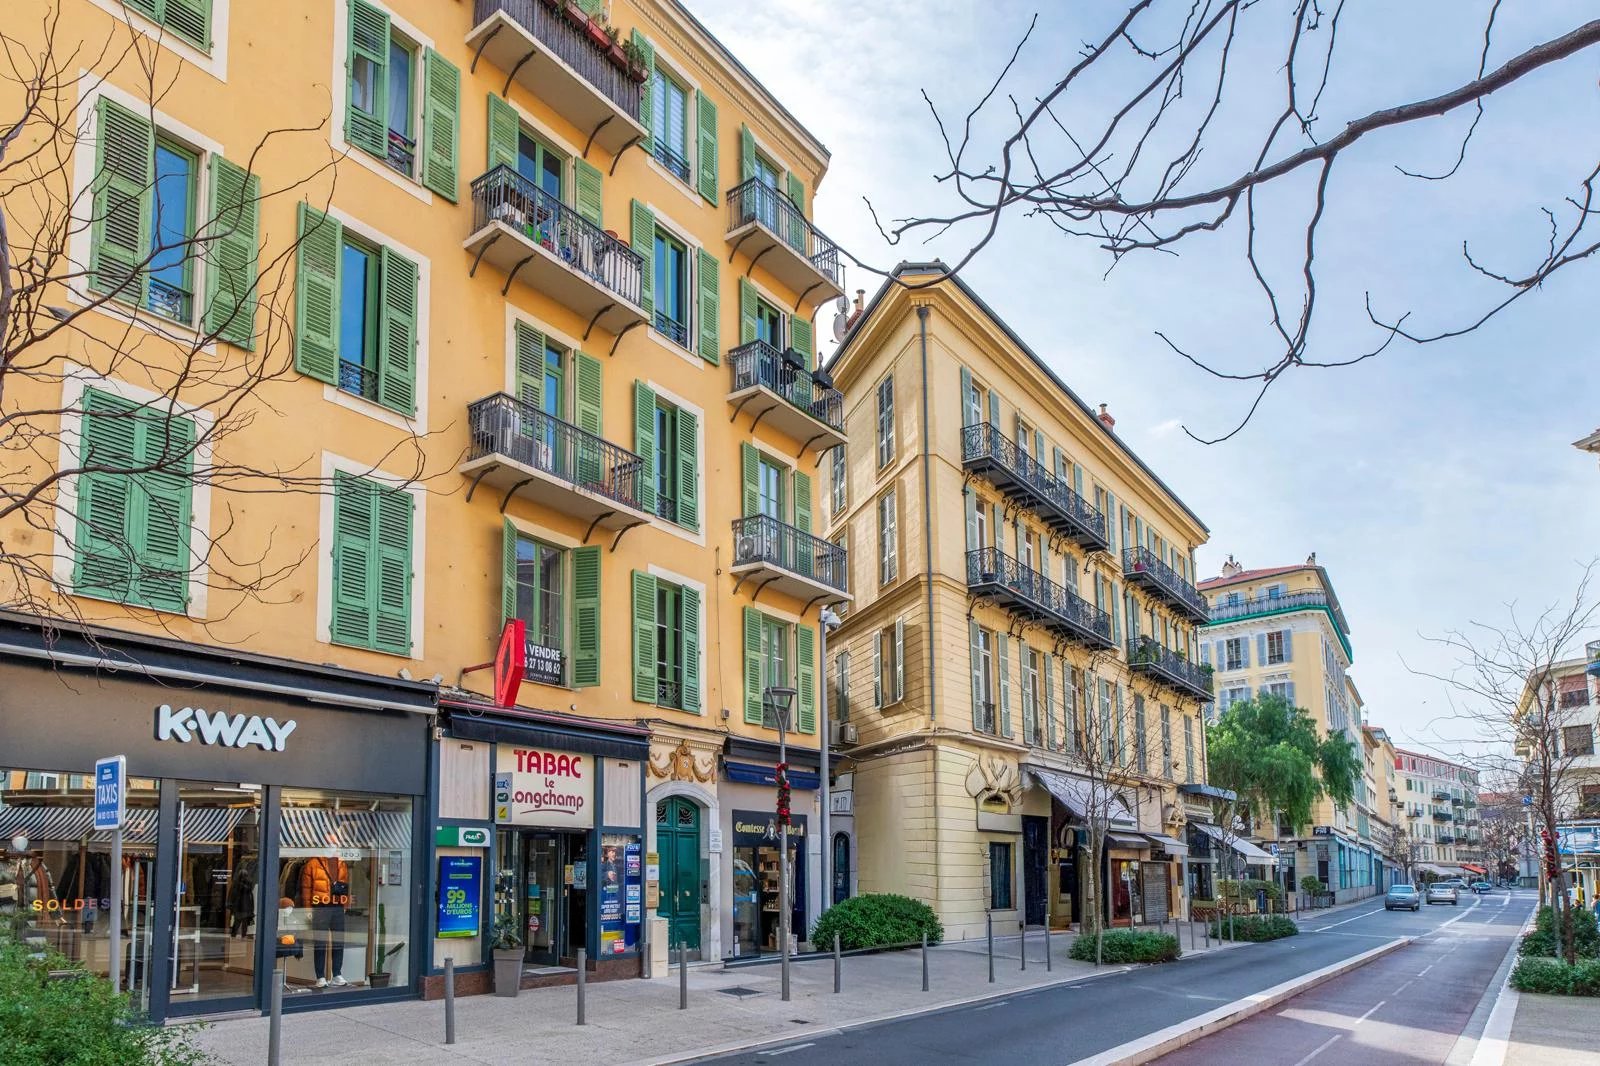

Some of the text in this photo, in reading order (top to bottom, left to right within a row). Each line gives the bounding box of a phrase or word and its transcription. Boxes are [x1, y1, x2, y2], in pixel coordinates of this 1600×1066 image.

[528, 643, 561, 661] VENDRE
[529, 658, 537, 669] 27
[537, 659, 545, 671] 13
[553, 663, 561, 675] 62
[513, 749, 582, 778] TABAC
[97, 783, 118, 805] TAXIS
[512, 789, 584, 811] ongchamp
[735, 821, 765, 834] Comtesse
[32, 897, 110, 912] SOLDES
[447, 889, 466, 904] 99
